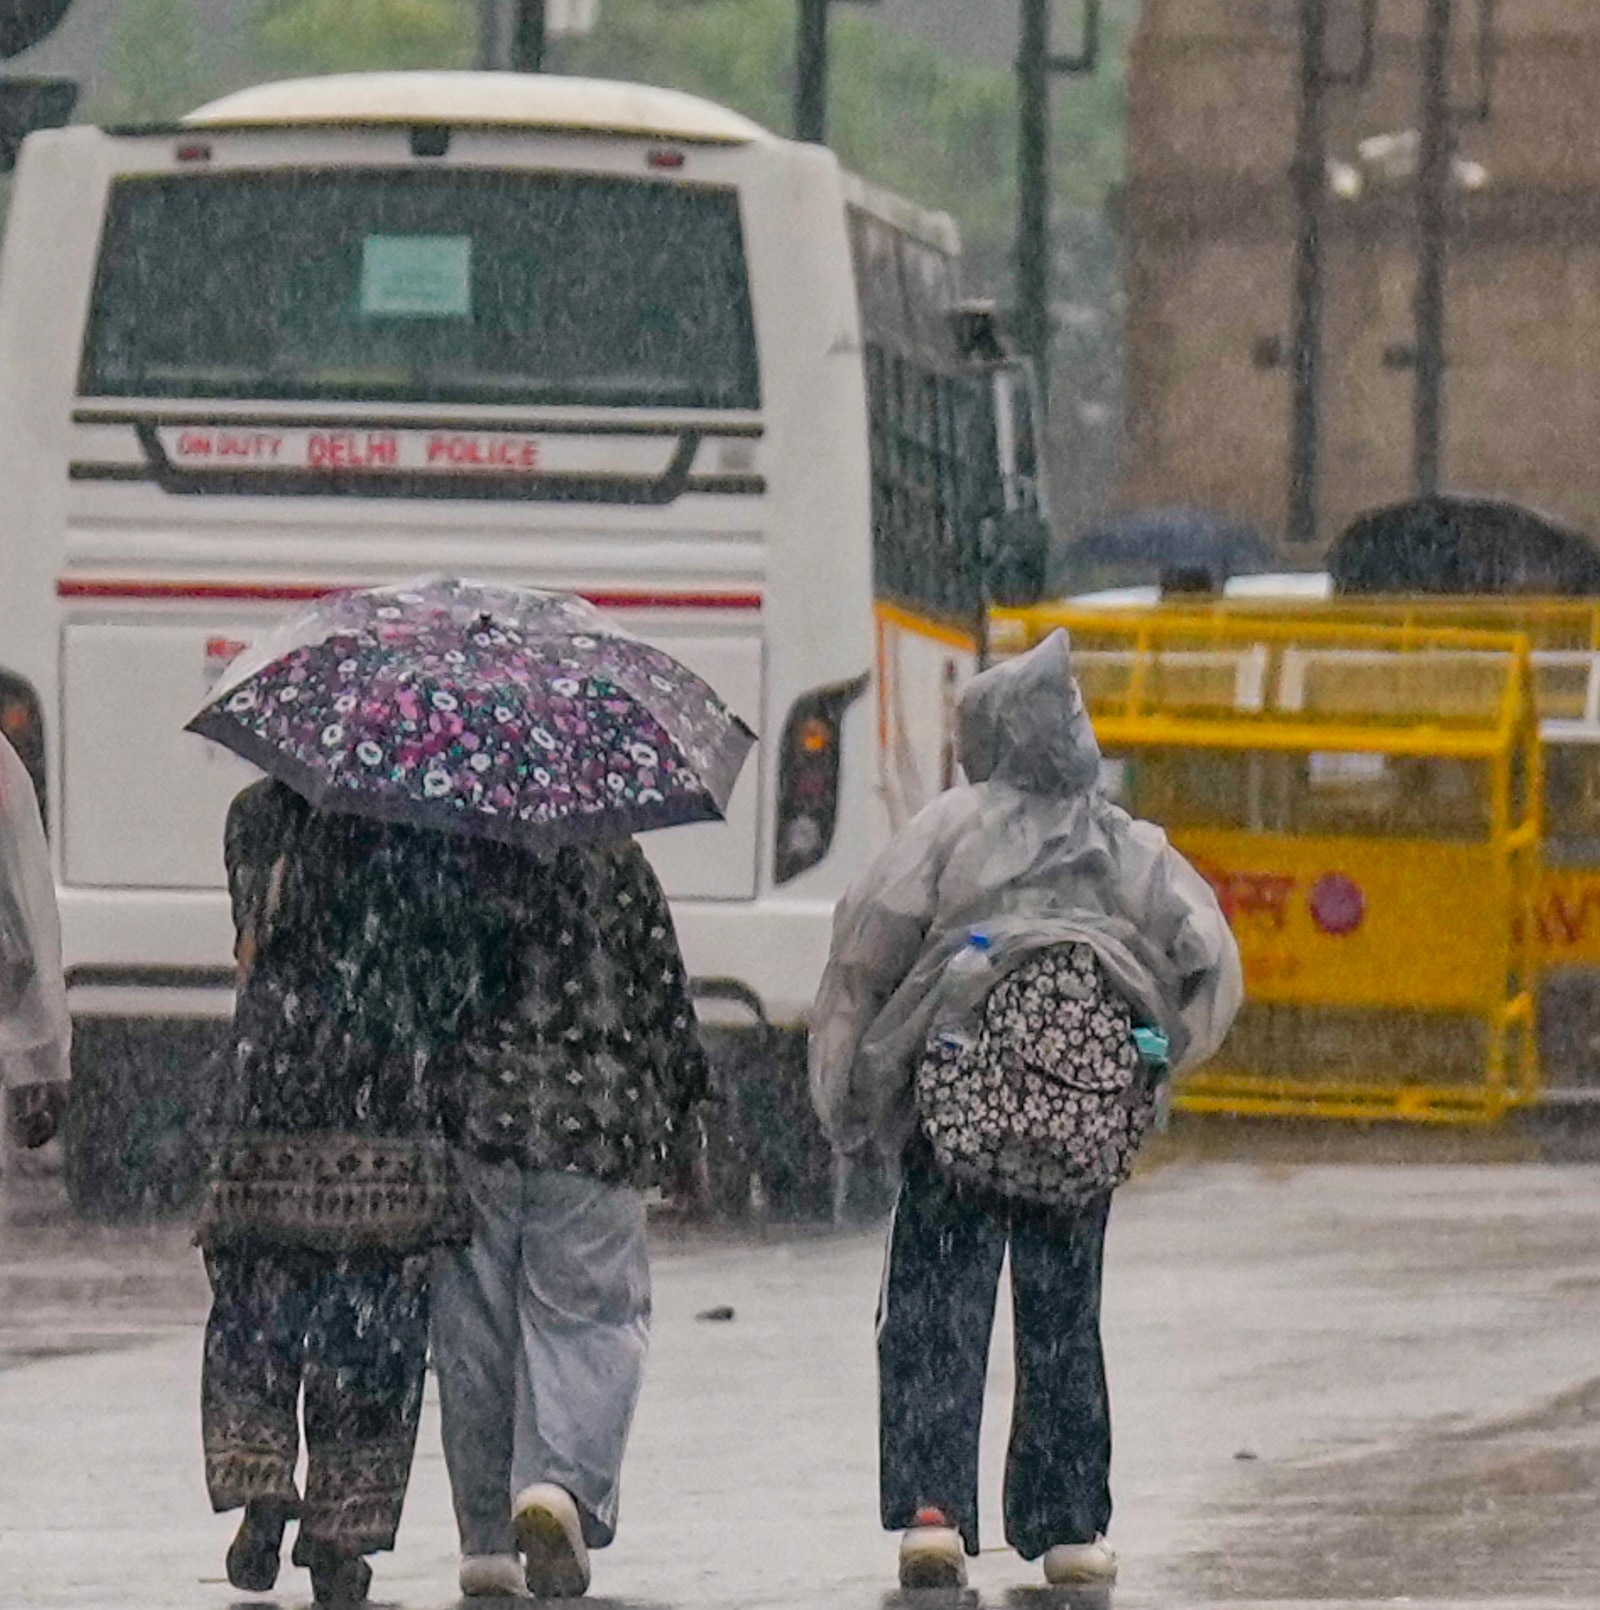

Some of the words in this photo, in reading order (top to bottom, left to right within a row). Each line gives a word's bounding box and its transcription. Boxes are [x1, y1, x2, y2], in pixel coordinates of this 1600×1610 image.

[216, 434, 282, 458] DUTY
[307, 432, 398, 468] DELHI
[426, 435, 542, 467] POLICE
